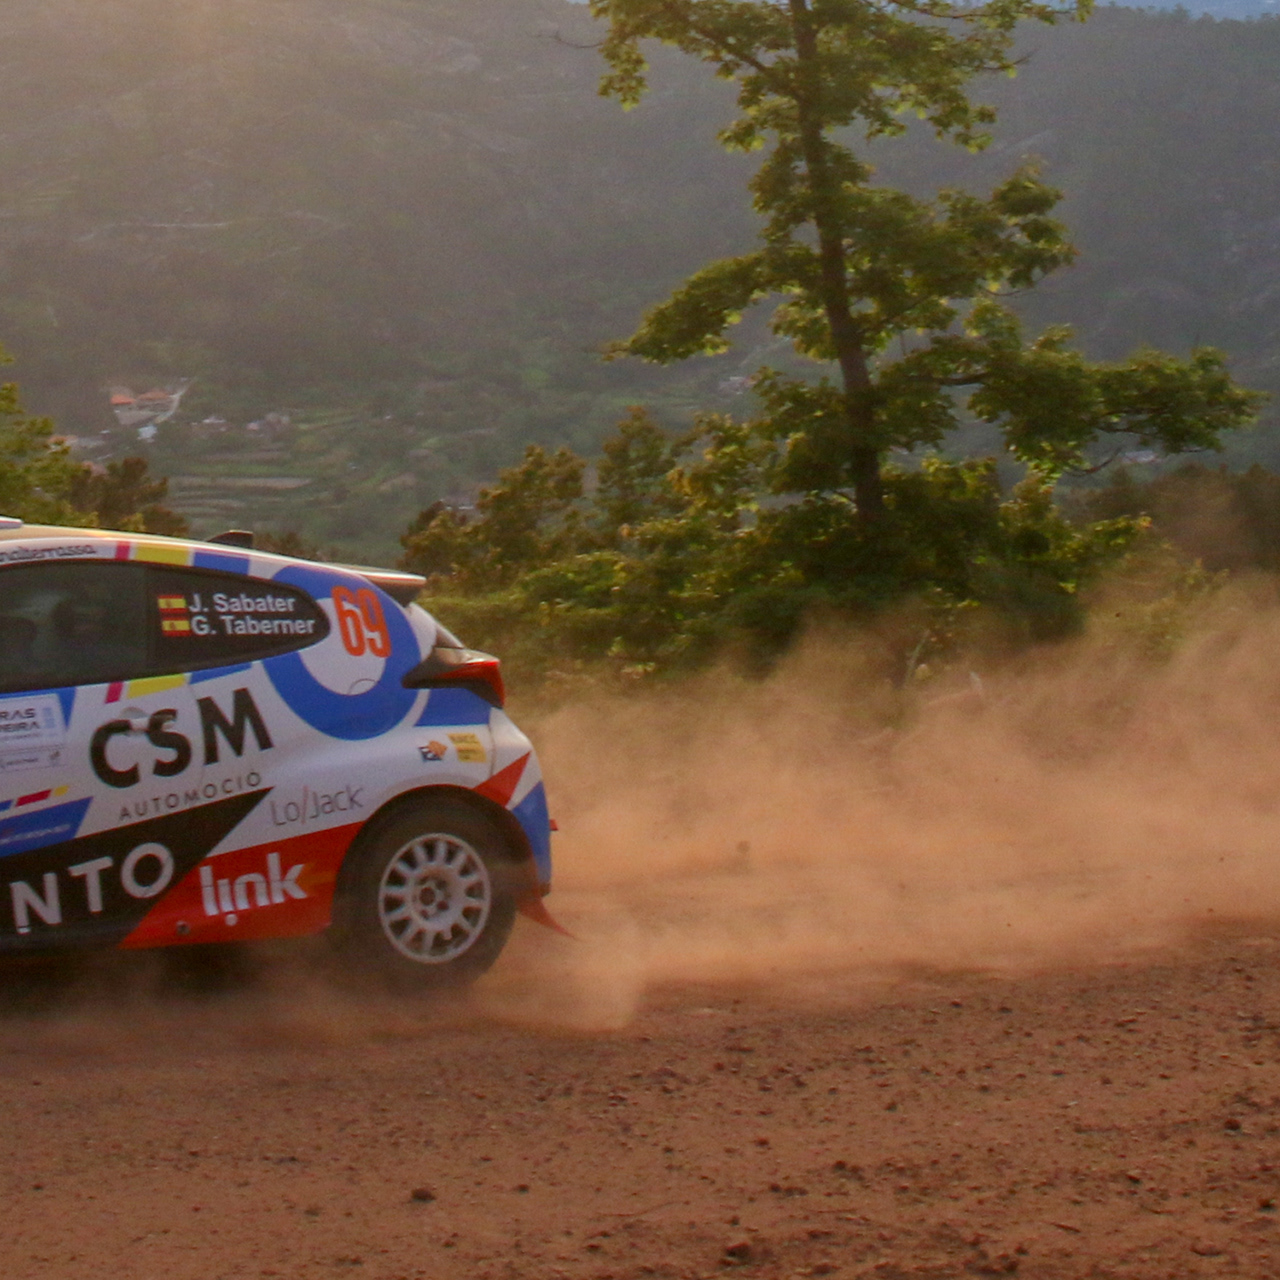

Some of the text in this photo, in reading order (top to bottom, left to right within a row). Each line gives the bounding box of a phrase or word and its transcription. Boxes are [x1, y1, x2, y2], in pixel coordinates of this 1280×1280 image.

[189, 593, 296, 613] J. Sabater
[191, 615, 316, 635] G. Taberner
[331, 585, 392, 658] 69
[90, 687, 274, 788] CSM
[199, 852, 308, 926] link
